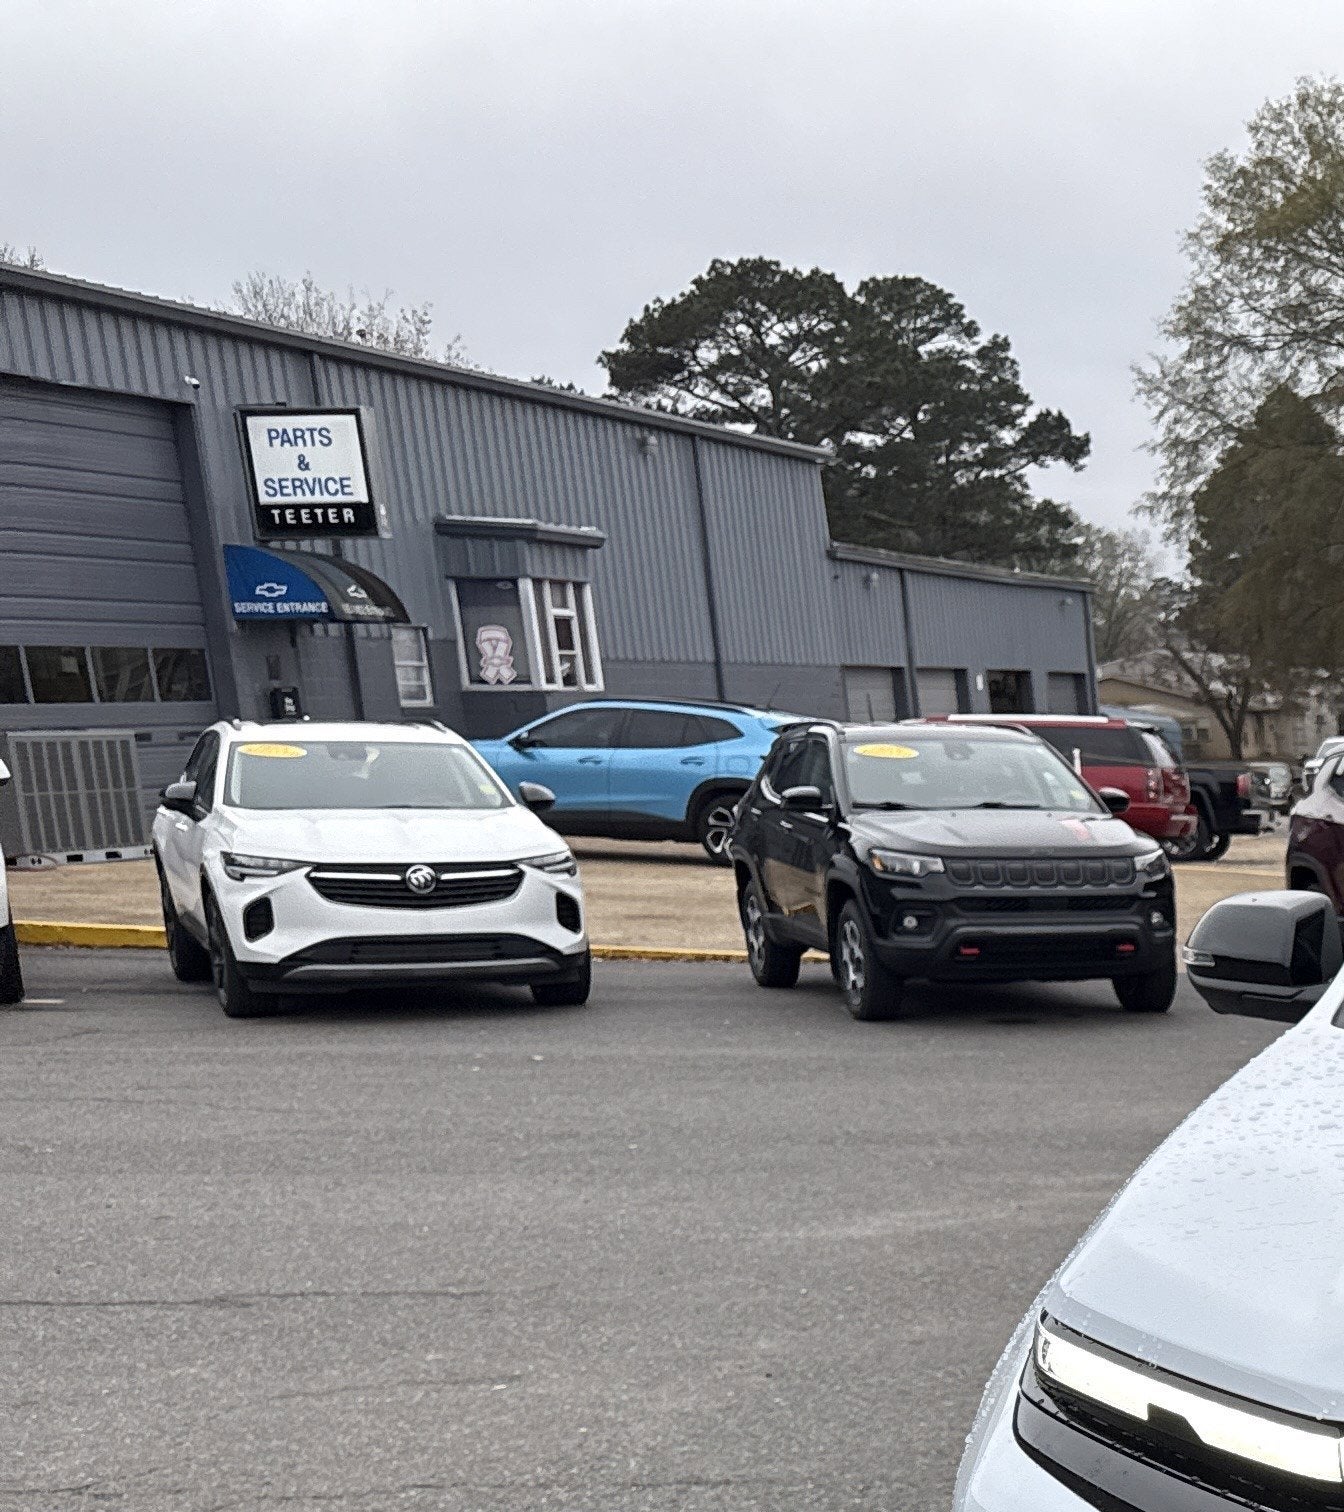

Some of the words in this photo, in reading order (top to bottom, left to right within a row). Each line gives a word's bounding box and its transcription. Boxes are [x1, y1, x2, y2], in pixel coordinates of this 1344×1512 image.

[267, 427, 333, 448] PARTS
[297, 453, 310, 471] &
[263, 476, 354, 498] SERVICE
[270, 507, 356, 525] TEETER
[234, 602, 275, 613] SERVICE
[277, 602, 328, 613] ENTRANCE
